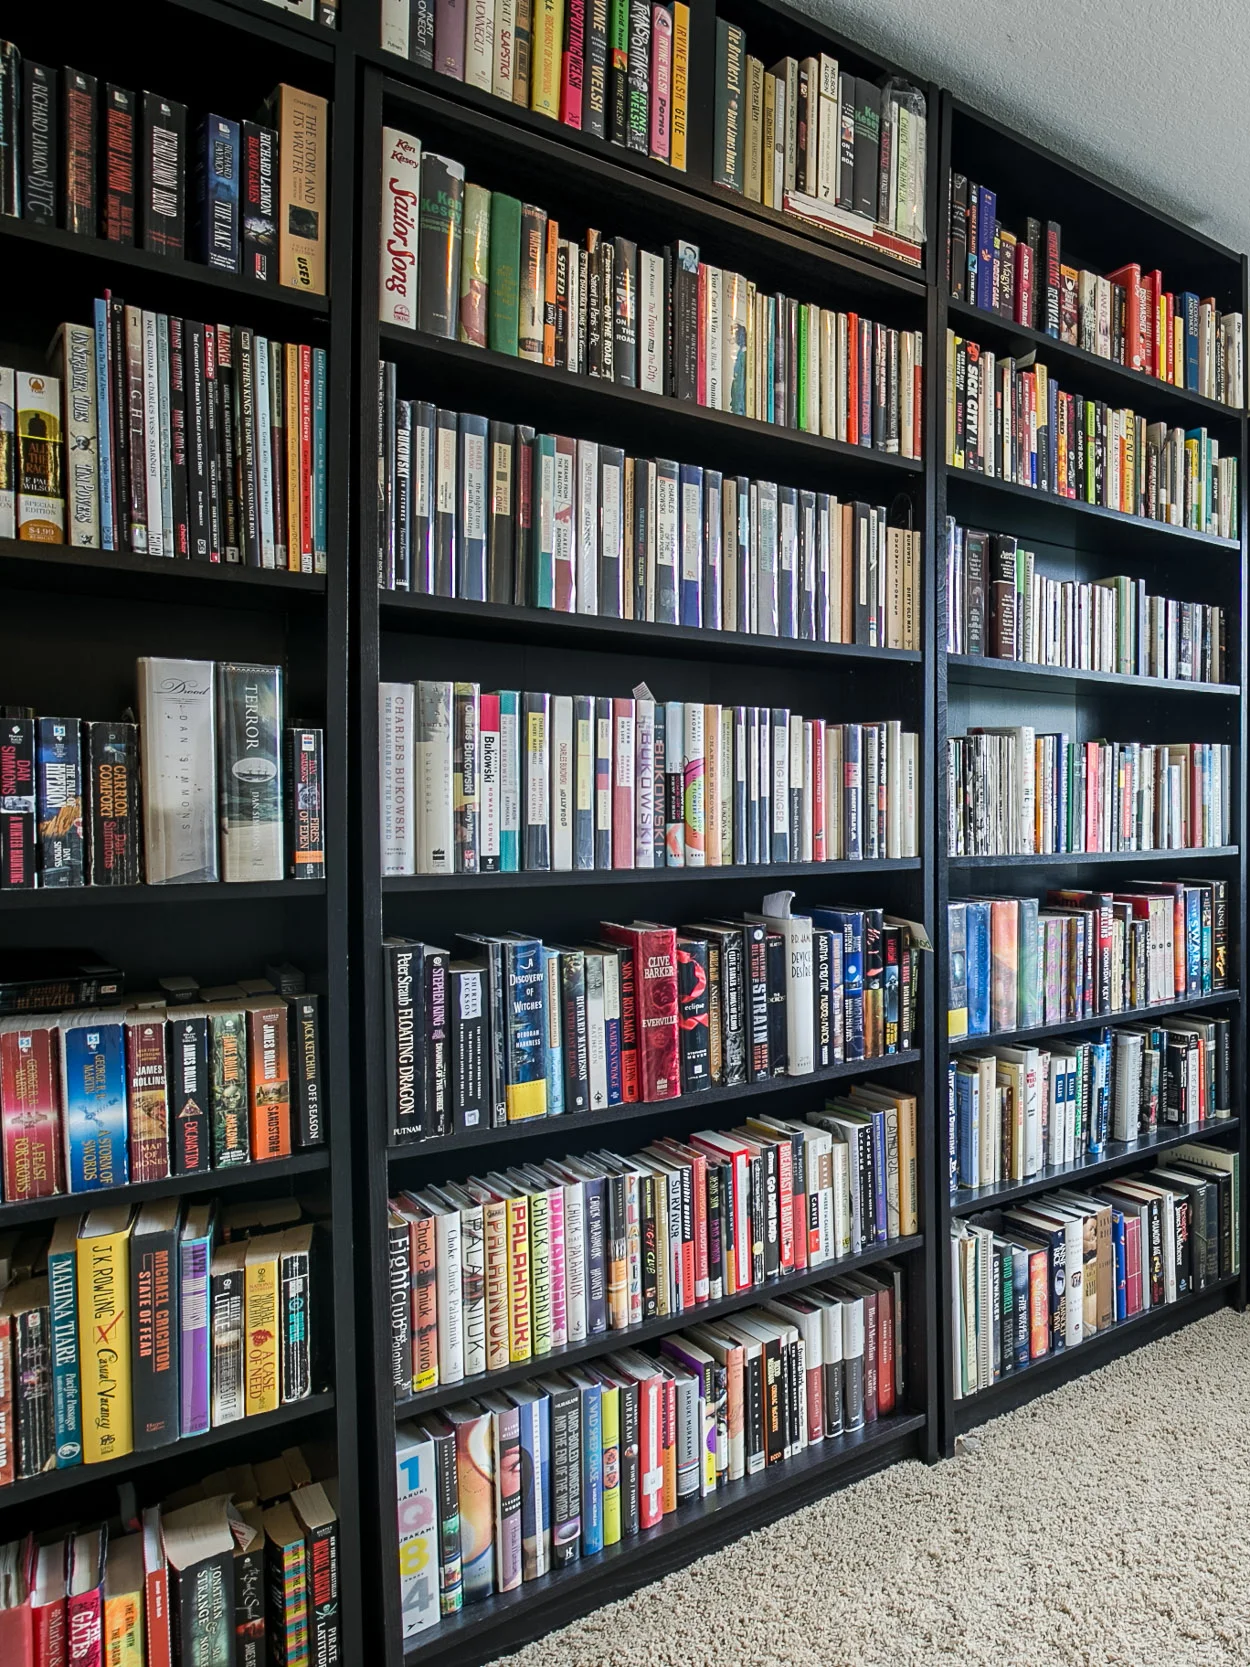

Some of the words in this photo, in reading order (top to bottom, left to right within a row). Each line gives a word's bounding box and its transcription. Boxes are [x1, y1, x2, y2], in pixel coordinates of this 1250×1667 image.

[658, 35, 670, 63] IRVINE
[676, 24, 687, 62] IRVINE
[728, 27, 742, 43] The
[657, 64, 669, 94] WELSH
[728, 44, 741, 82] Brothers
[675, 65, 687, 100] WELSH
[728, 81, 741, 94] K
[32, 83, 48, 131] RICHARD
[292, 109, 304, 126] ITS
[658, 97, 667, 135] Porno
[674, 108, 685, 135] GLUE
[726, 109, 737, 127] David
[305, 115, 317, 136] THE
[726, 128, 736, 149] James
[32, 132, 48, 176] LAYMON
[248, 136, 259, 169] BLOOD
[260, 132, 271, 175] RICHARD
[292, 128, 304, 174] WRITER
[305, 138, 317, 175] STORY
[390, 150, 418, 169] Kesey
[396, 139, 417, 153] Ken
[726, 149, 736, 174] Duncan
[248, 170, 259, 203] GAMES
[260, 176, 272, 216] LAYMON
[304, 176, 316, 204] AND
[214, 201, 231, 220] THE
[388, 178, 417, 246] Sailor
[214, 221, 232, 250] LAKE
[1047, 231, 1059, 258] STEPHEN
[296, 257, 310, 285] USED
[386, 239, 416, 297] Song
[557, 254, 566, 295] SPEED
[1001, 261, 1013, 292] Magyk
[1049, 259, 1061, 286] KING
[604, 305, 612, 319] ON
[1047, 287, 1059, 329] REVIVAL
[72, 330, 90, 349] ON
[604, 320, 612, 338] THE
[218, 330, 230, 367] MARVEL
[604, 339, 612, 365] ROAD
[71, 350, 91, 392] STRANGER
[241, 353, 252, 389] STEPHEN
[967, 364, 979, 398] SICK
[73, 396, 91, 422] TIDES
[243, 389, 252, 415] KING'S
[967, 402, 980, 435] CITY
[397, 428, 410, 479] BUKOWSKI
[75, 482, 93, 524] POWERS
[301, 553, 313, 573] VERTIGO
[245, 684, 259, 750] TERROR
[394, 696, 405, 761] CHARLES
[464, 705, 474, 741] Charles
[1, 746, 15, 795] SIMMONS
[15, 759, 30, 782] DAN
[65, 764, 75, 779] THE
[463, 742, 474, 793] Bukowski
[481, 736, 494, 783] Bukowski
[776, 759, 784, 778] BIG
[46, 763, 66, 808] HYPERION
[66, 779, 75, 796] FALL
[66, 797, 76, 807] OF
[99, 764, 113, 818] COMFORT
[113, 765, 127, 817] CARRION
[776, 780, 784, 823] HUNGER
[300, 811, 309, 824] OF
[395, 767, 405, 840] BUKOWSKI
[9, 823, 23, 848] WINTER
[300, 826, 310, 849] EDEN
[310, 817, 320, 842] FIRES
[10, 849, 24, 884] HAUNTING
[397, 953, 412, 976] Peter
[622, 961, 633, 980] SON
[398, 976, 412, 1006] Straub
[432, 968, 443, 1005] STEPHEN
[463, 977, 471, 1016] JACKSON
[470, 977, 478, 1014] SHIRLEY
[623, 983, 633, 996] OF
[302, 1020, 314, 1039] JACK
[433, 1008, 444, 1026] KING
[576, 996, 586, 1034] RICHARD
[623, 997, 635, 1043] ROSEMARY
[752, 984, 767, 1044] STRAIN
[263, 1024, 275, 1049] JAMES
[398, 1009, 413, 1064] FLOATING
[183, 1045, 196, 1066] JAMES
[264, 1050, 276, 1080] ROLLINS
[305, 1040, 315, 1080] KETCHUM
[577, 1036, 587, 1081] MATHESON
[183, 1066, 197, 1093] ROLLINS
[308, 1084, 317, 1101] OFF
[399, 1066, 414, 1115] DRAGON
[267, 1106, 280, 1153] SANDSTORM
[308, 1104, 319, 1139] SEASON
[15, 1137, 28, 1155] FOR
[32, 1142, 44, 1150] A
[83, 1140, 97, 1181] SWORDS
[99, 1138, 112, 1169] STORM
[184, 1121, 199, 1169] EXCAVATION
[15, 1156, 31, 1192] CROWS
[32, 1149, 46, 1181] FEAST
[101, 1171, 113, 1184] OF
[417, 1220, 430, 1257] Chuck
[533, 1198, 548, 1249] CHUCK
[447, 1230, 458, 1260] Choke
[155, 1250, 169, 1306] MICHAEL
[448, 1264, 458, 1296] Chuck
[512, 1206, 529, 1346] PALAHNIUK
[1003, 1256, 1013, 1279] DAVID
[52, 1259, 74, 1321] MAHINA
[139, 1271, 152, 1308] STATE
[419, 1261, 432, 1317] Palahniuk
[466, 1218, 484, 1356] PALAHNIUK
[487, 1221, 505, 1357] PALAHNIUK
[534, 1257, 551, 1343] PALAHNIUK
[1004, 1280, 1013, 1315] MORRELL
[139, 1310, 151, 1325] OF
[449, 1300, 460, 1350] Palahniuk
[54, 1321, 76, 1366] TIARE
[139, 1328, 152, 1357] FEAR
[155, 1310, 170, 1372] CRICHTON
[262, 1351, 274, 1359] A
[1004, 1319, 1013, 1359] CREEPERS
[249, 1349, 261, 1365] OF
[249, 1367, 263, 1399] NEED
[262, 1361, 275, 1392] CASE
[95, 1384, 118, 1429] Vacancy
[624, 1393, 633, 1443] MURAKAMI
[554, 1415, 566, 1433] AND
[555, 1434, 566, 1448] THE
[567, 1410, 579, 1462] HARD-BOILED
[556, 1450, 567, 1467] END
[556, 1468, 567, 1478] OF
[556, 1479, 568, 1495] THE
[569, 1463, 580, 1517] WONDERLAND
[557, 1497, 568, 1522] WORLD
[197, 1570, 209, 1625] STRANGE
[210, 1565, 222, 1620] JONATHAN
[72, 1611, 92, 1658] GATES
[327, 1627, 337, 1663] PIRATE
